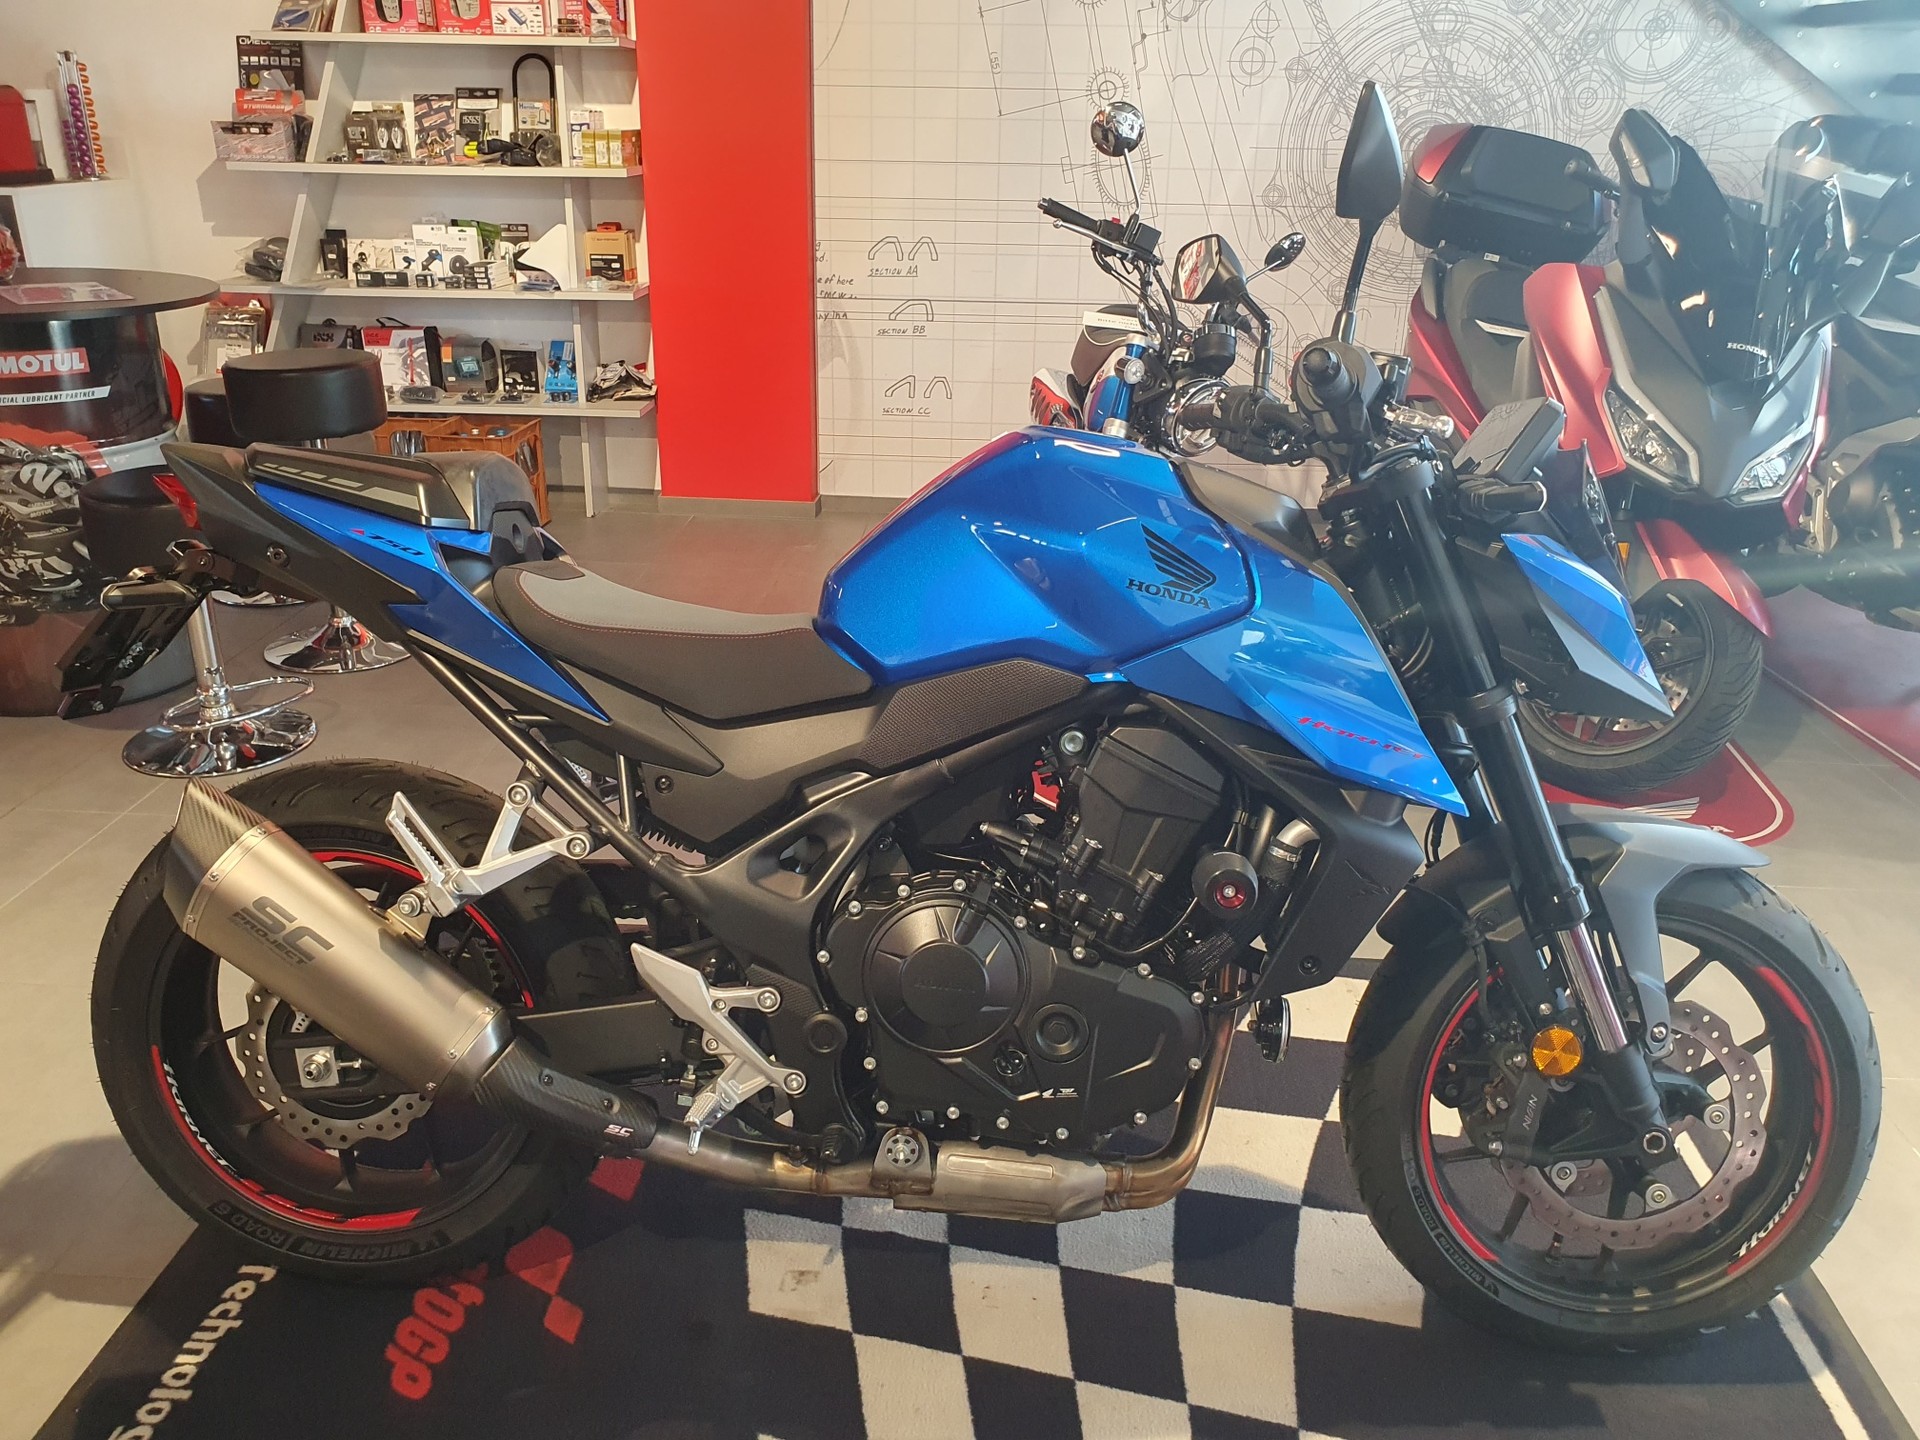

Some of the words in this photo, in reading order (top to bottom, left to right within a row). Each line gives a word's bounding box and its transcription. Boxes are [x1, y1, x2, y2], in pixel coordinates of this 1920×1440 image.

[869, 267, 902, 276] SECTION
[906, 265, 918, 276] AA
[878, 327, 908, 336] SECTION
[912, 325, 926, 334] BB
[1726, 342, 1768, 358] HONDA
[0, 352, 85, 374] MOTUL
[22, 394, 62, 403] LUBRICANT
[65, 390, 96, 400] PARTNER
[917, 407, 931, 415] CC
[368, 532, 426, 557] 750
[1125, 577, 1212, 610] HONDA
[232, 911, 309, 966] PROJECT
[240, 895, 335, 962] SC
[230, 1213, 288, 1246] ROAD
